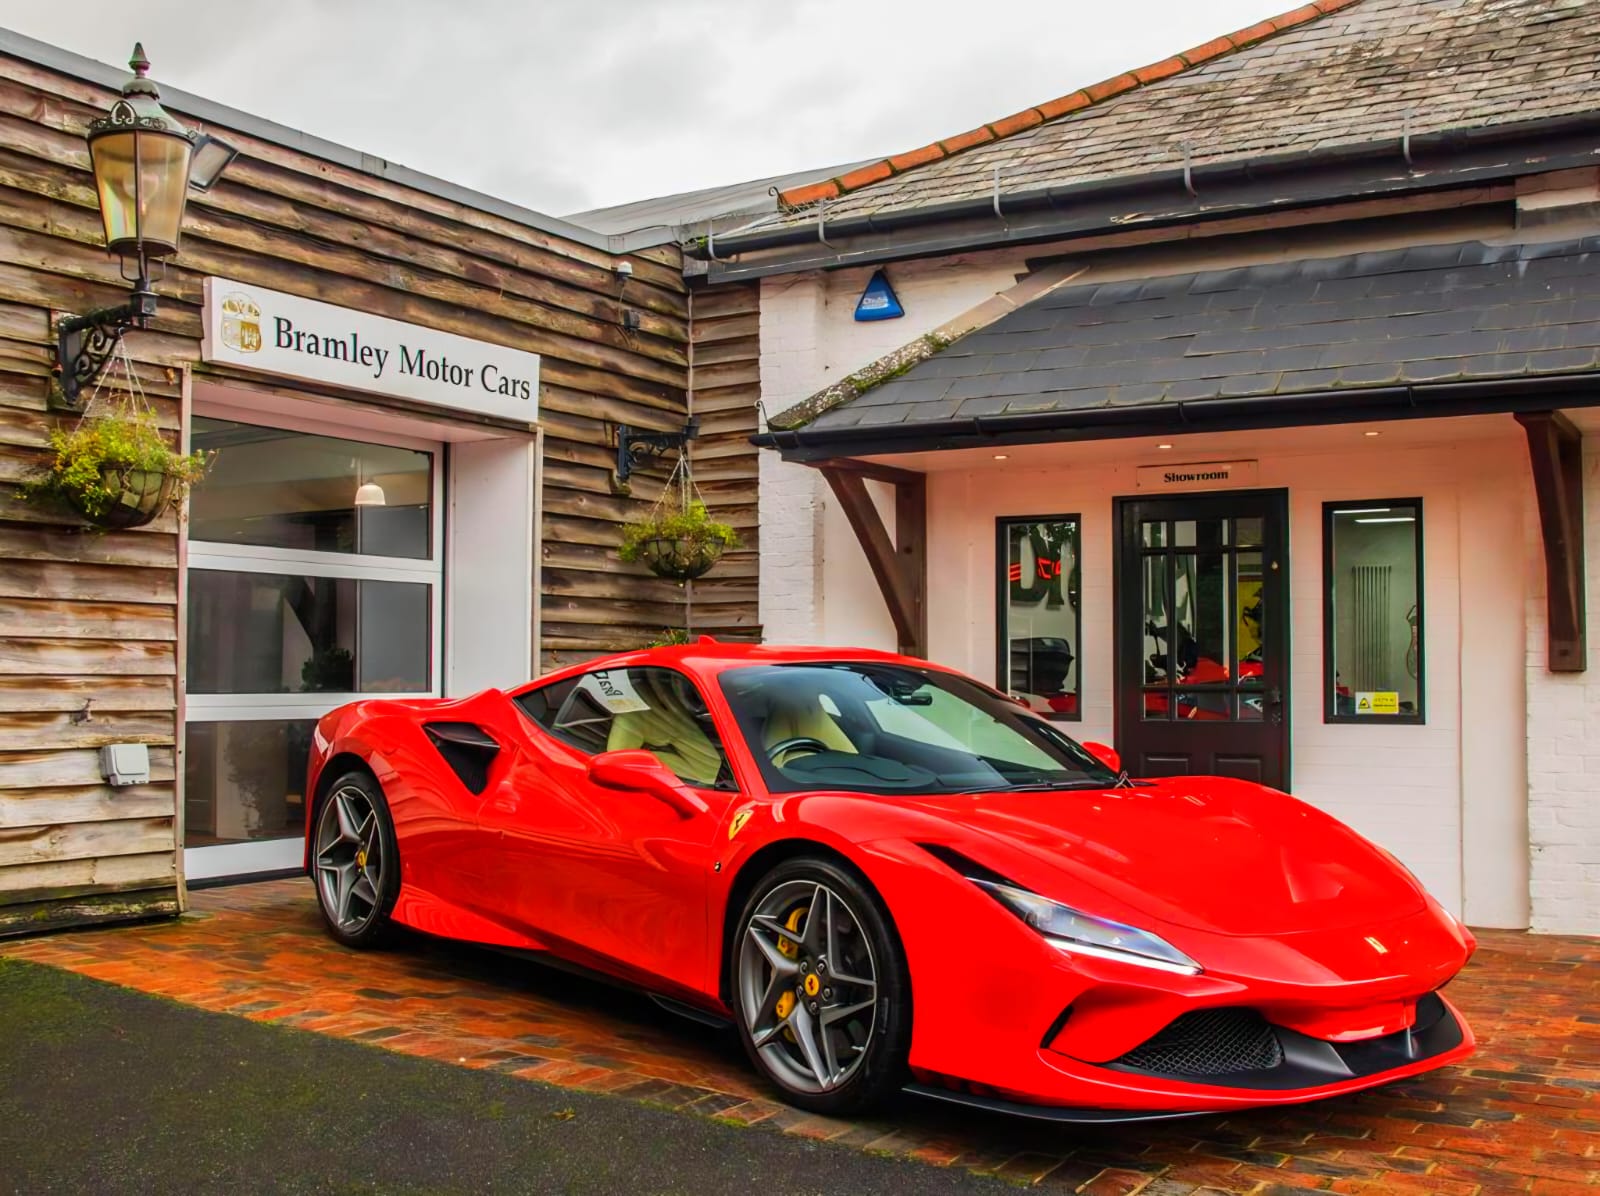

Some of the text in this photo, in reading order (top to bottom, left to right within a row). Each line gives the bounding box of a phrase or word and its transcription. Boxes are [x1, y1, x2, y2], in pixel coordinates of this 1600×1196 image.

[274, 316, 530, 400] Bramley Motor Cars
[1163, 471, 1229, 483] Showroom
